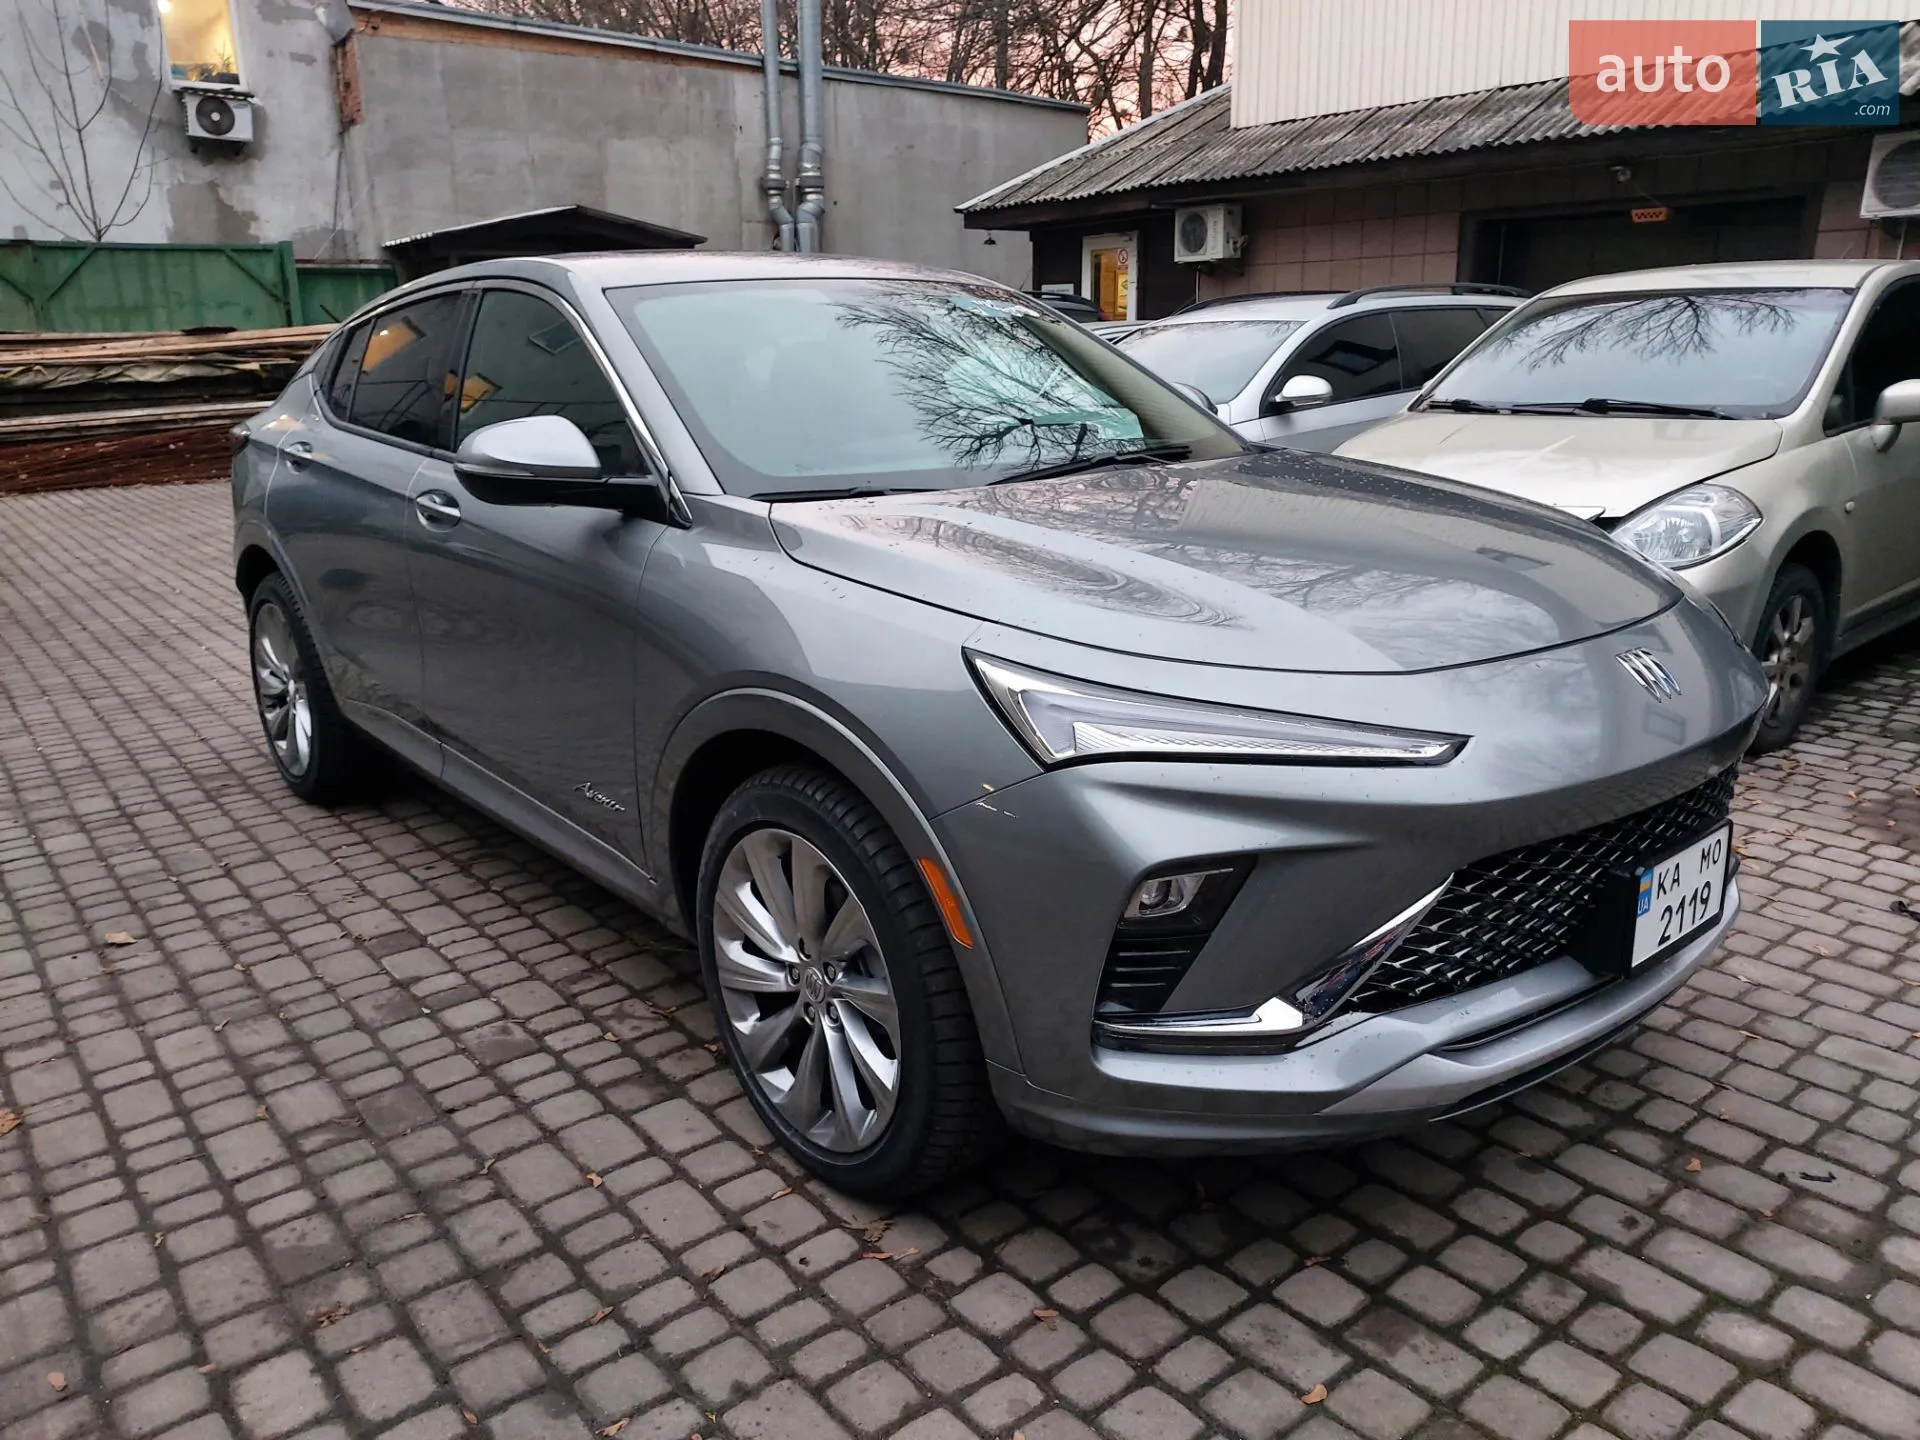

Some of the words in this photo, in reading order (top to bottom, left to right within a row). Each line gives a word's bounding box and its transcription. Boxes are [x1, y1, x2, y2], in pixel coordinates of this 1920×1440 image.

[1656, 862, 1681, 900] KA
[1699, 838, 1722, 874] MO
[1637, 896, 1650, 914] UA
[1657, 880, 1712, 947] 2119
